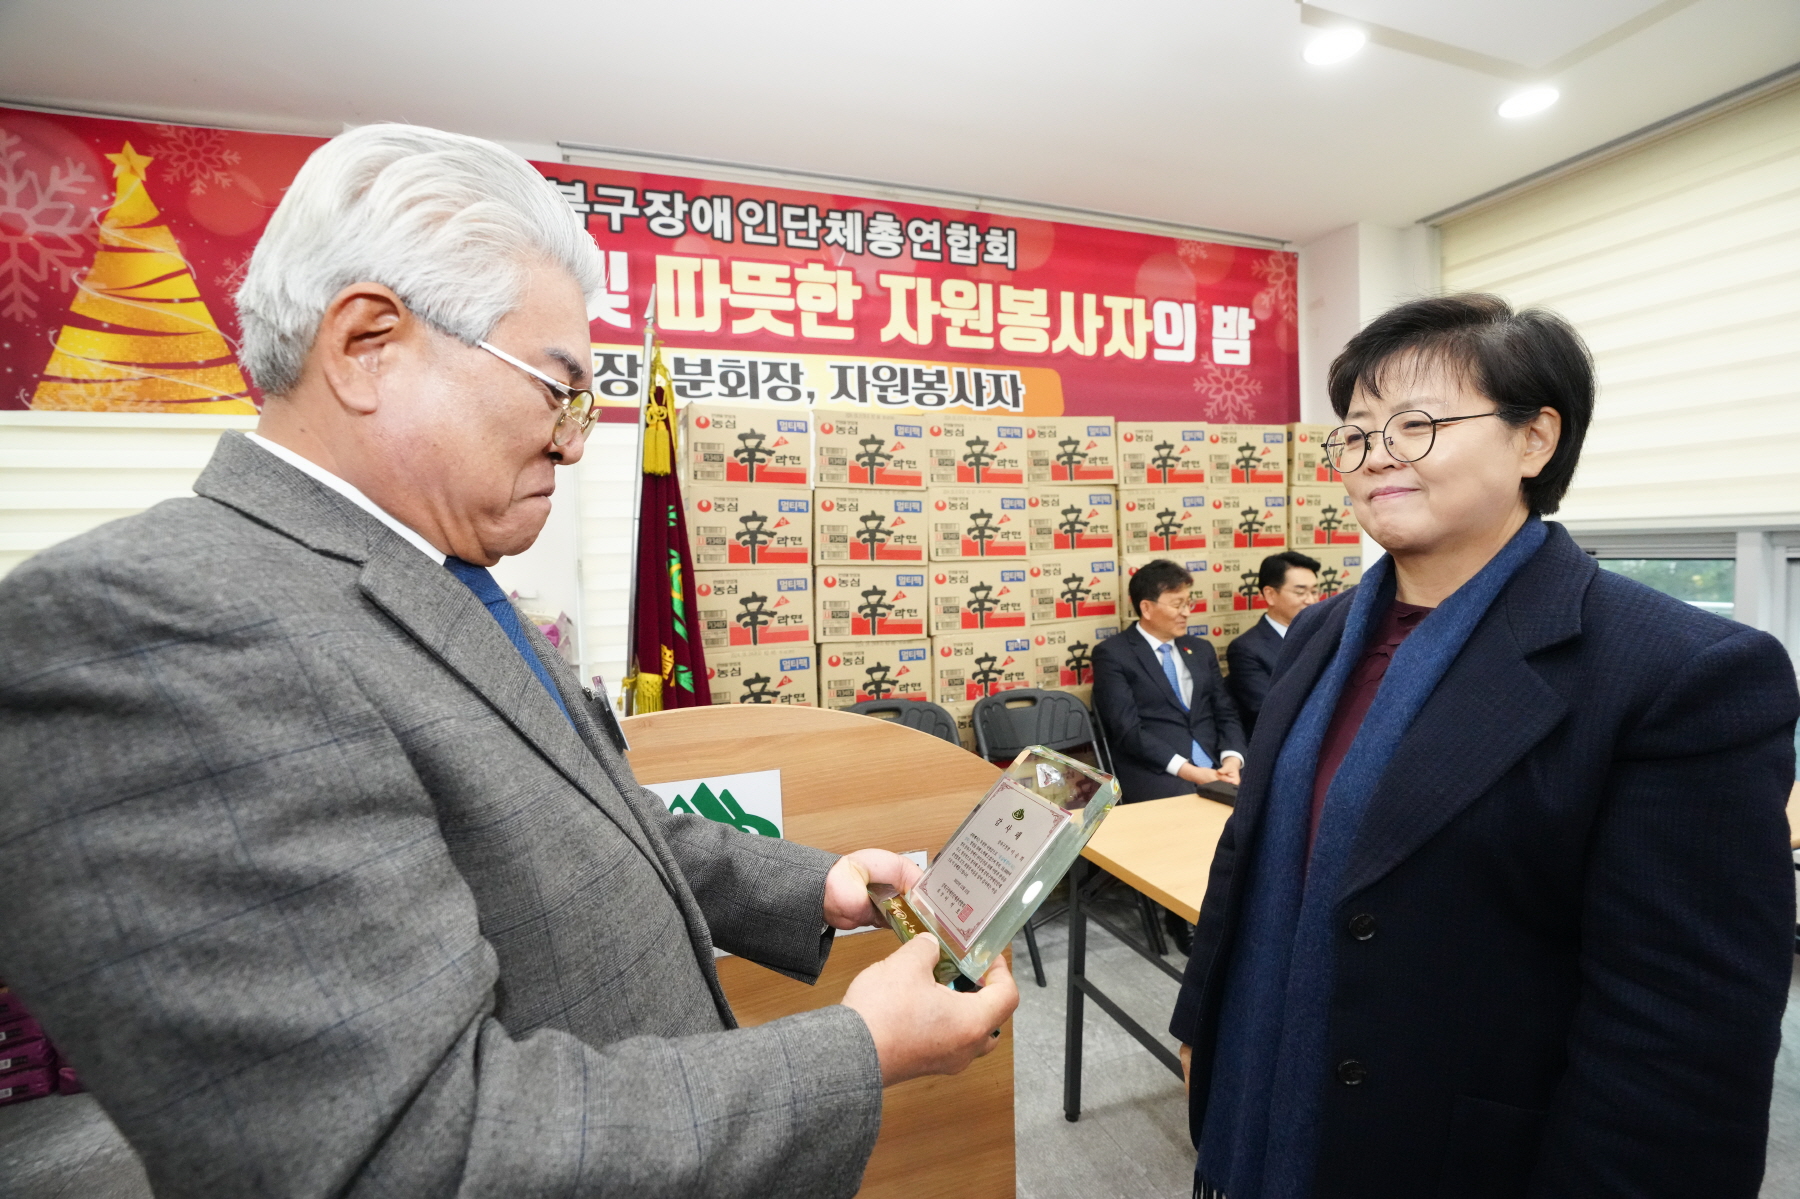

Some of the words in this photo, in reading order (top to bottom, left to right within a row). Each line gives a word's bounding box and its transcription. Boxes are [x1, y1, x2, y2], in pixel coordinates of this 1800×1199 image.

[655, 254, 863, 341] 따뜻한
[879, 273, 1197, 363] 자원봉사자의
[1212, 305, 1256, 366] 밤
[672, 356, 816, 404] 분회장,
[829, 364, 1023, 409] 자원봉사자
[712, 419, 736, 429] 농심
[780, 422, 806, 431] 멀티팩
[836, 425, 857, 435] 농심
[944, 428, 964, 437] 농심
[734, 428, 775, 483] 辛
[775, 455, 801, 466] 라면
[856, 434, 893, 485] 辛
[893, 459, 917, 469] 라면
[963, 435, 997, 484] 辛
[997, 459, 1018, 468] 라면
[1056, 436, 1088, 481] 辛
[1152, 440, 1181, 484] 辛
[1236, 442, 1262, 484] 辛
[714, 502, 738, 512] 농심
[781, 502, 806, 511] 멀티팩
[837, 503, 858, 512] 농심
[949, 502, 968, 510] 농심
[1059, 504, 1090, 549] 辛
[1239, 506, 1265, 548] 辛
[1319, 504, 1342, 544] 辛
[736, 510, 777, 565] 辛
[777, 536, 802, 547] 라면
[856, 510, 894, 561] 辛
[894, 534, 917, 545] 라면
[967, 509, 1001, 557] 辛
[1001, 531, 1021, 540] 라면
[1154, 508, 1184, 551] 辛
[714, 585, 738, 595] 농심
[780, 580, 805, 590] 멀티팩
[839, 578, 860, 587] 농심
[949, 575, 968, 584] 농심
[1061, 573, 1091, 618] 辛
[736, 592, 777, 645] 辛
[777, 614, 803, 625] 라면
[858, 585, 895, 635] 辛
[895, 609, 918, 618] 라면
[967, 581, 1000, 629] 辛
[1001, 603, 1020, 612] 라면
[783, 659, 807, 669] 멀티팩
[843, 656, 864, 666] 농심
[954, 647, 973, 656] 농심
[1066, 640, 1092, 685] 辛
[718, 668, 741, 678] 농심
[863, 662, 899, 700] 辛
[899, 682, 922, 693] 라면
[972, 652, 1004, 697] 辛
[1005, 672, 1025, 682] 라면
[781, 693, 805, 704] 라면
